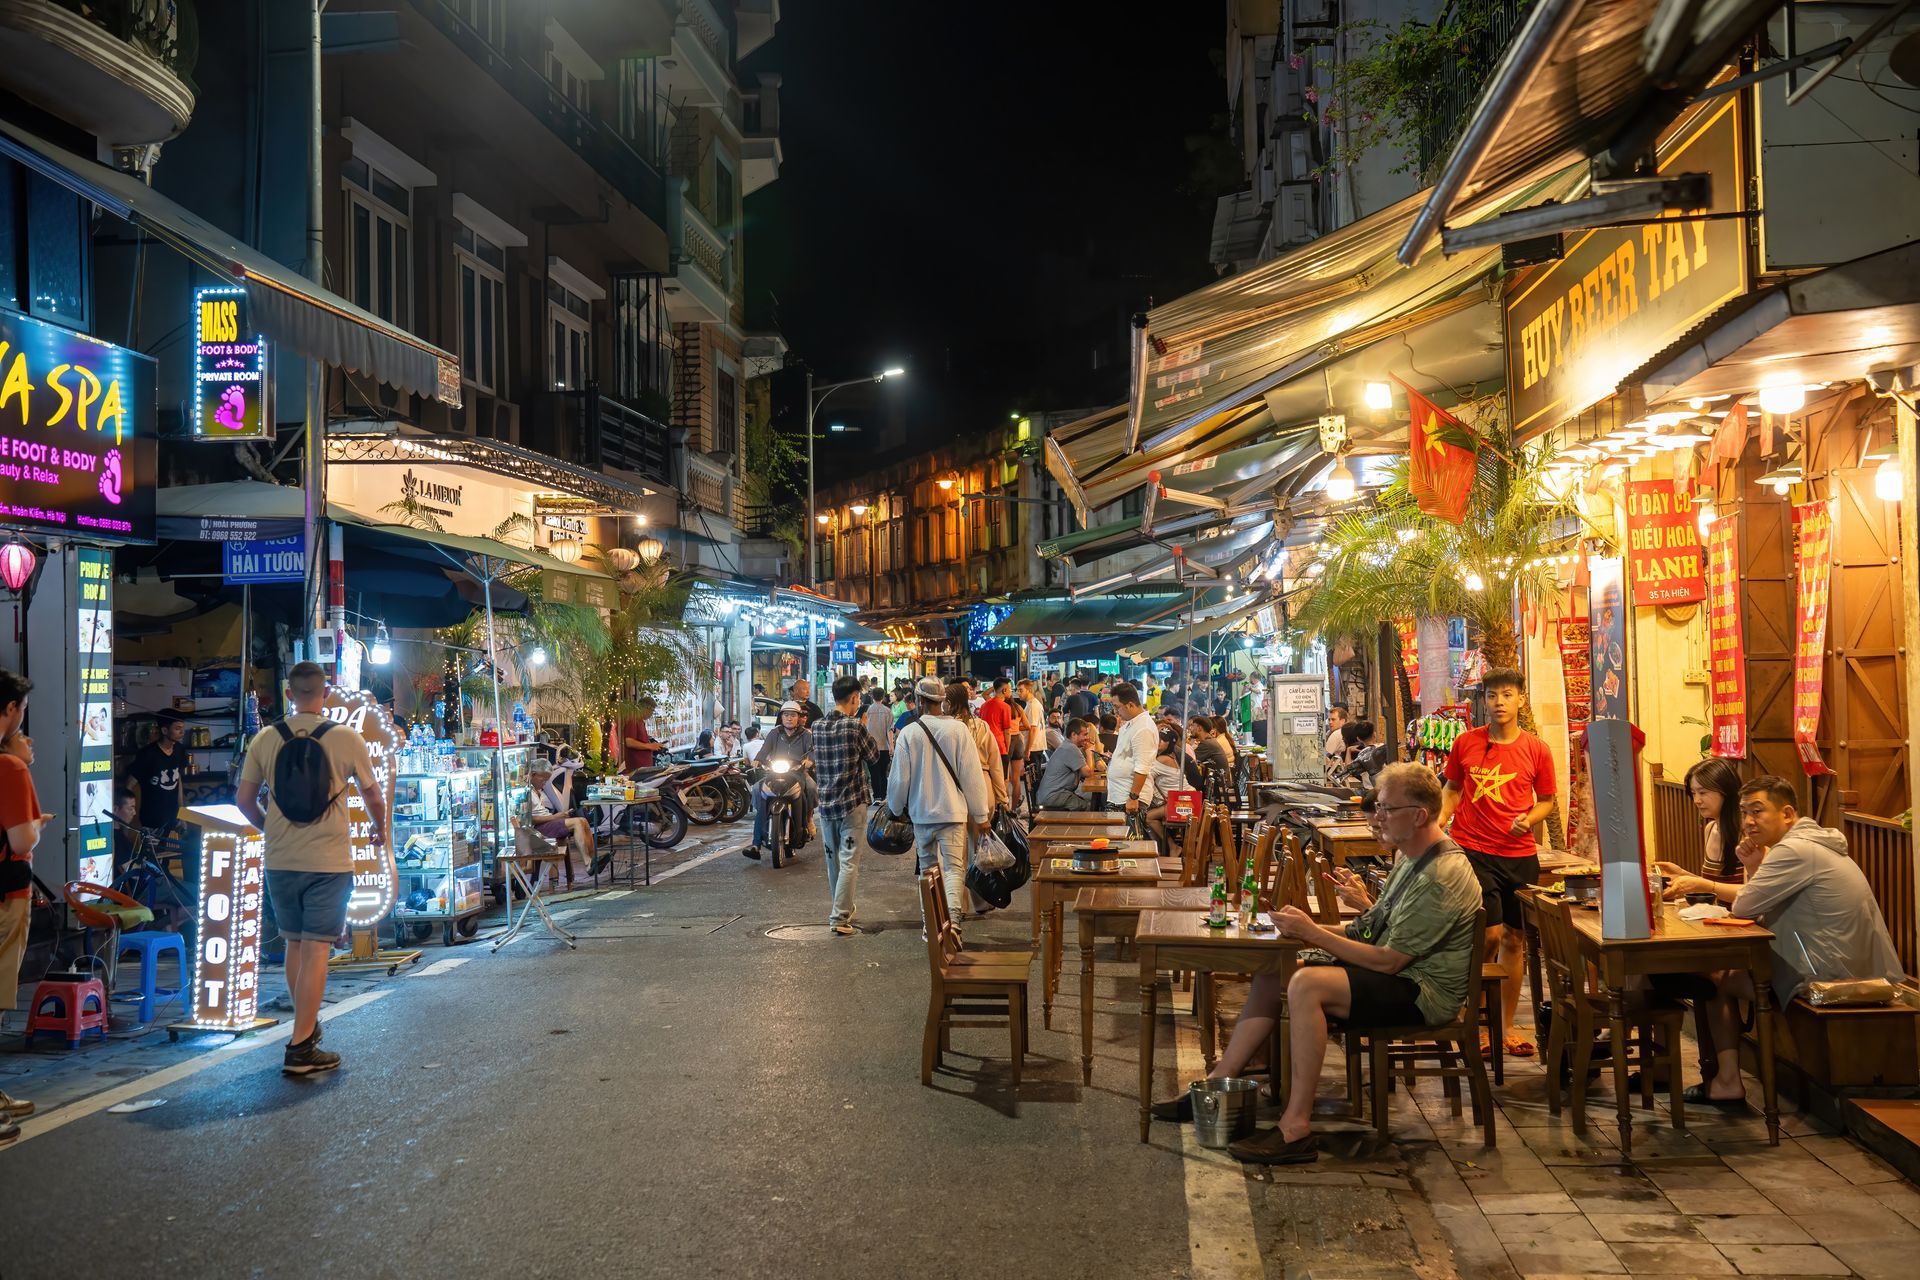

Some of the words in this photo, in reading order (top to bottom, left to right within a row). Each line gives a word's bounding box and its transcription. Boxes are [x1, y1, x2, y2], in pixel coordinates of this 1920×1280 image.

[201, 300, 238, 342] MASS
[1521, 296, 1565, 390] HUY
[1568, 239, 1639, 353] BEER
[201, 345, 226, 355] FOOT
[226, 345, 234, 355] &
[234, 345, 259, 355] BODY
[201, 371, 233, 382] PRIVATE
[233, 371, 260, 381] ROOM
[46, 364, 127, 446] SPA
[12, 439, 48, 463] FOOT
[50, 447, 60, 465] &
[63, 450, 97, 473] BODY
[23, 464, 31, 480] &
[33, 467, 60, 485] Relax
[1628, 487, 1637, 517] Ở
[1641, 488, 1669, 516] ĐÂY
[213, 520, 229, 529] HOÀI
[230, 520, 257, 530] PHƯƠNG
[230, 531, 242, 541] 552
[243, 531, 257, 541] 522
[1631, 520, 1663, 551] ĐIỀU
[1666, 520, 1697, 548] HOÀ
[232, 549, 259, 574] HÀI
[1634, 555, 1699, 587] LẠNH
[1649, 590, 1659, 600] 35
[1659, 589, 1671, 600] TẠ
[1671, 586, 1690, 599] HIỆN
[204, 850, 231, 1008] FOOT
[239, 840, 262, 1018] MASSAGE
